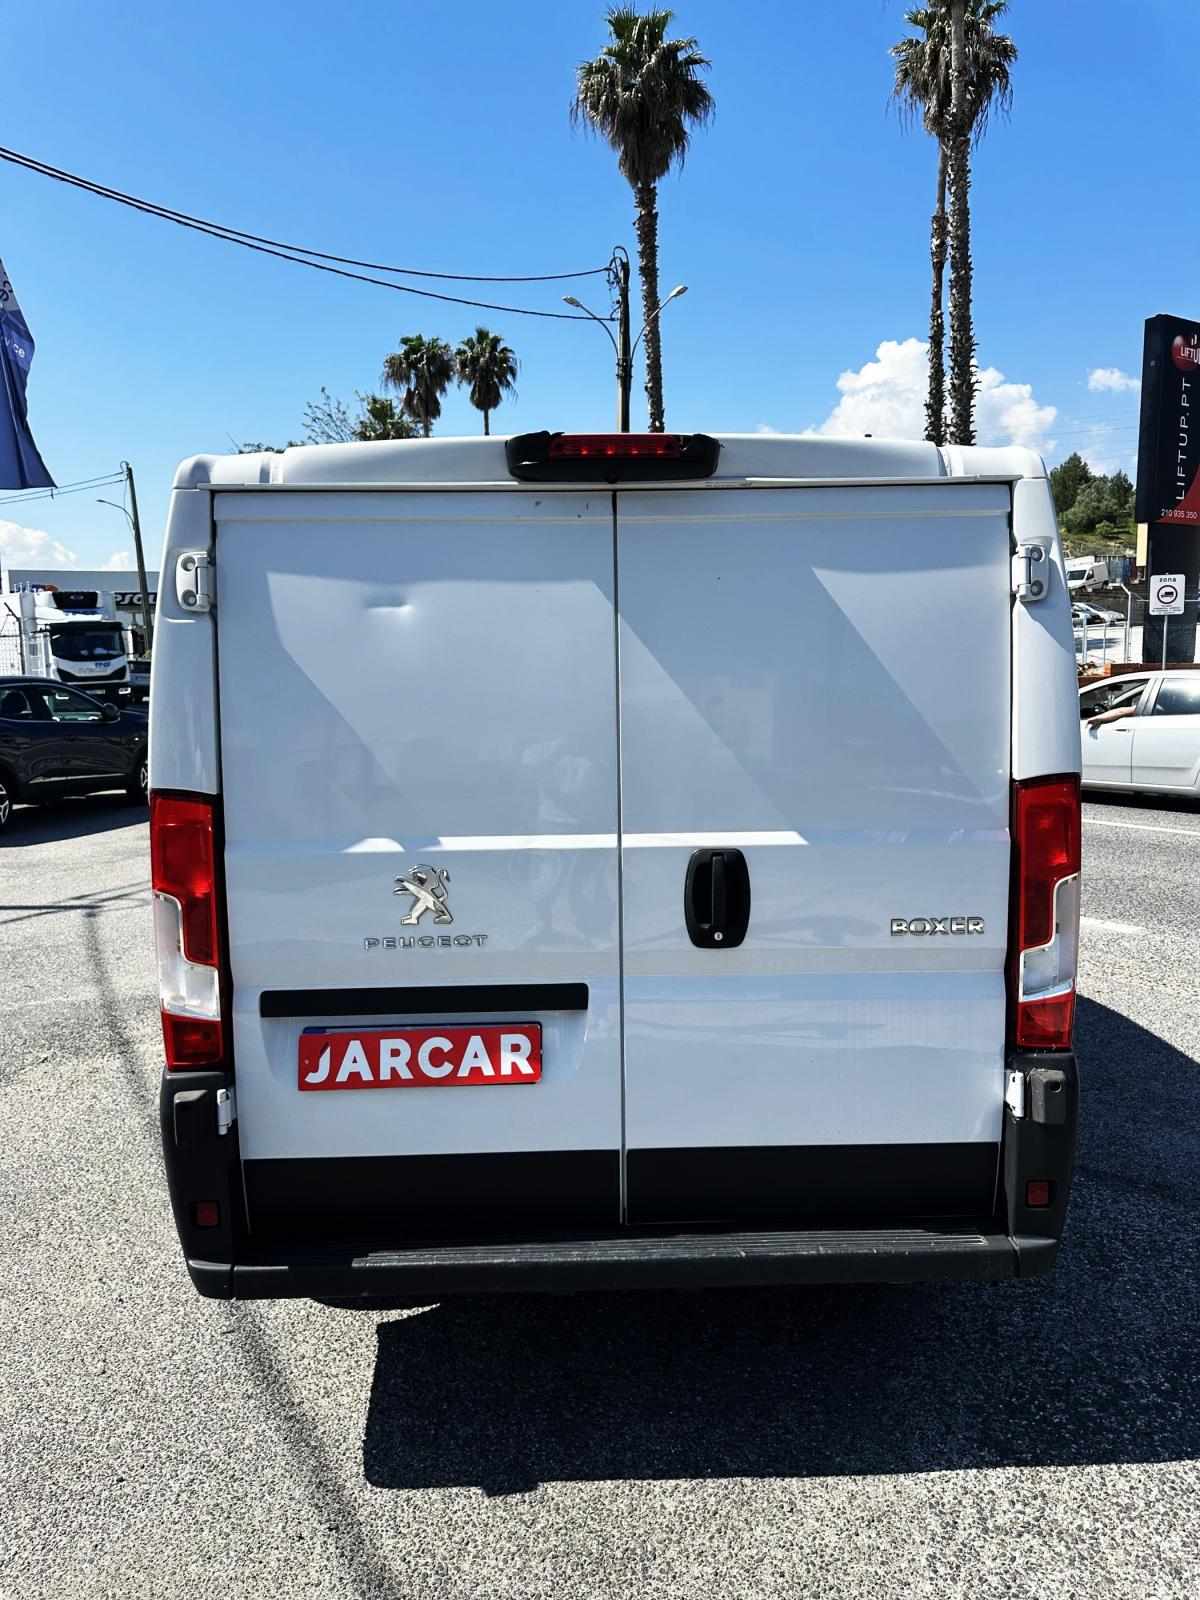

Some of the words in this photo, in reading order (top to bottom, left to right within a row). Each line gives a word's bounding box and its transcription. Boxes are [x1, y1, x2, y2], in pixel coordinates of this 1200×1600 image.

[890, 916, 985, 936] BOXER
[364, 934, 488, 950] PEUGEOT
[305, 1034, 535, 1084] JARCAR
